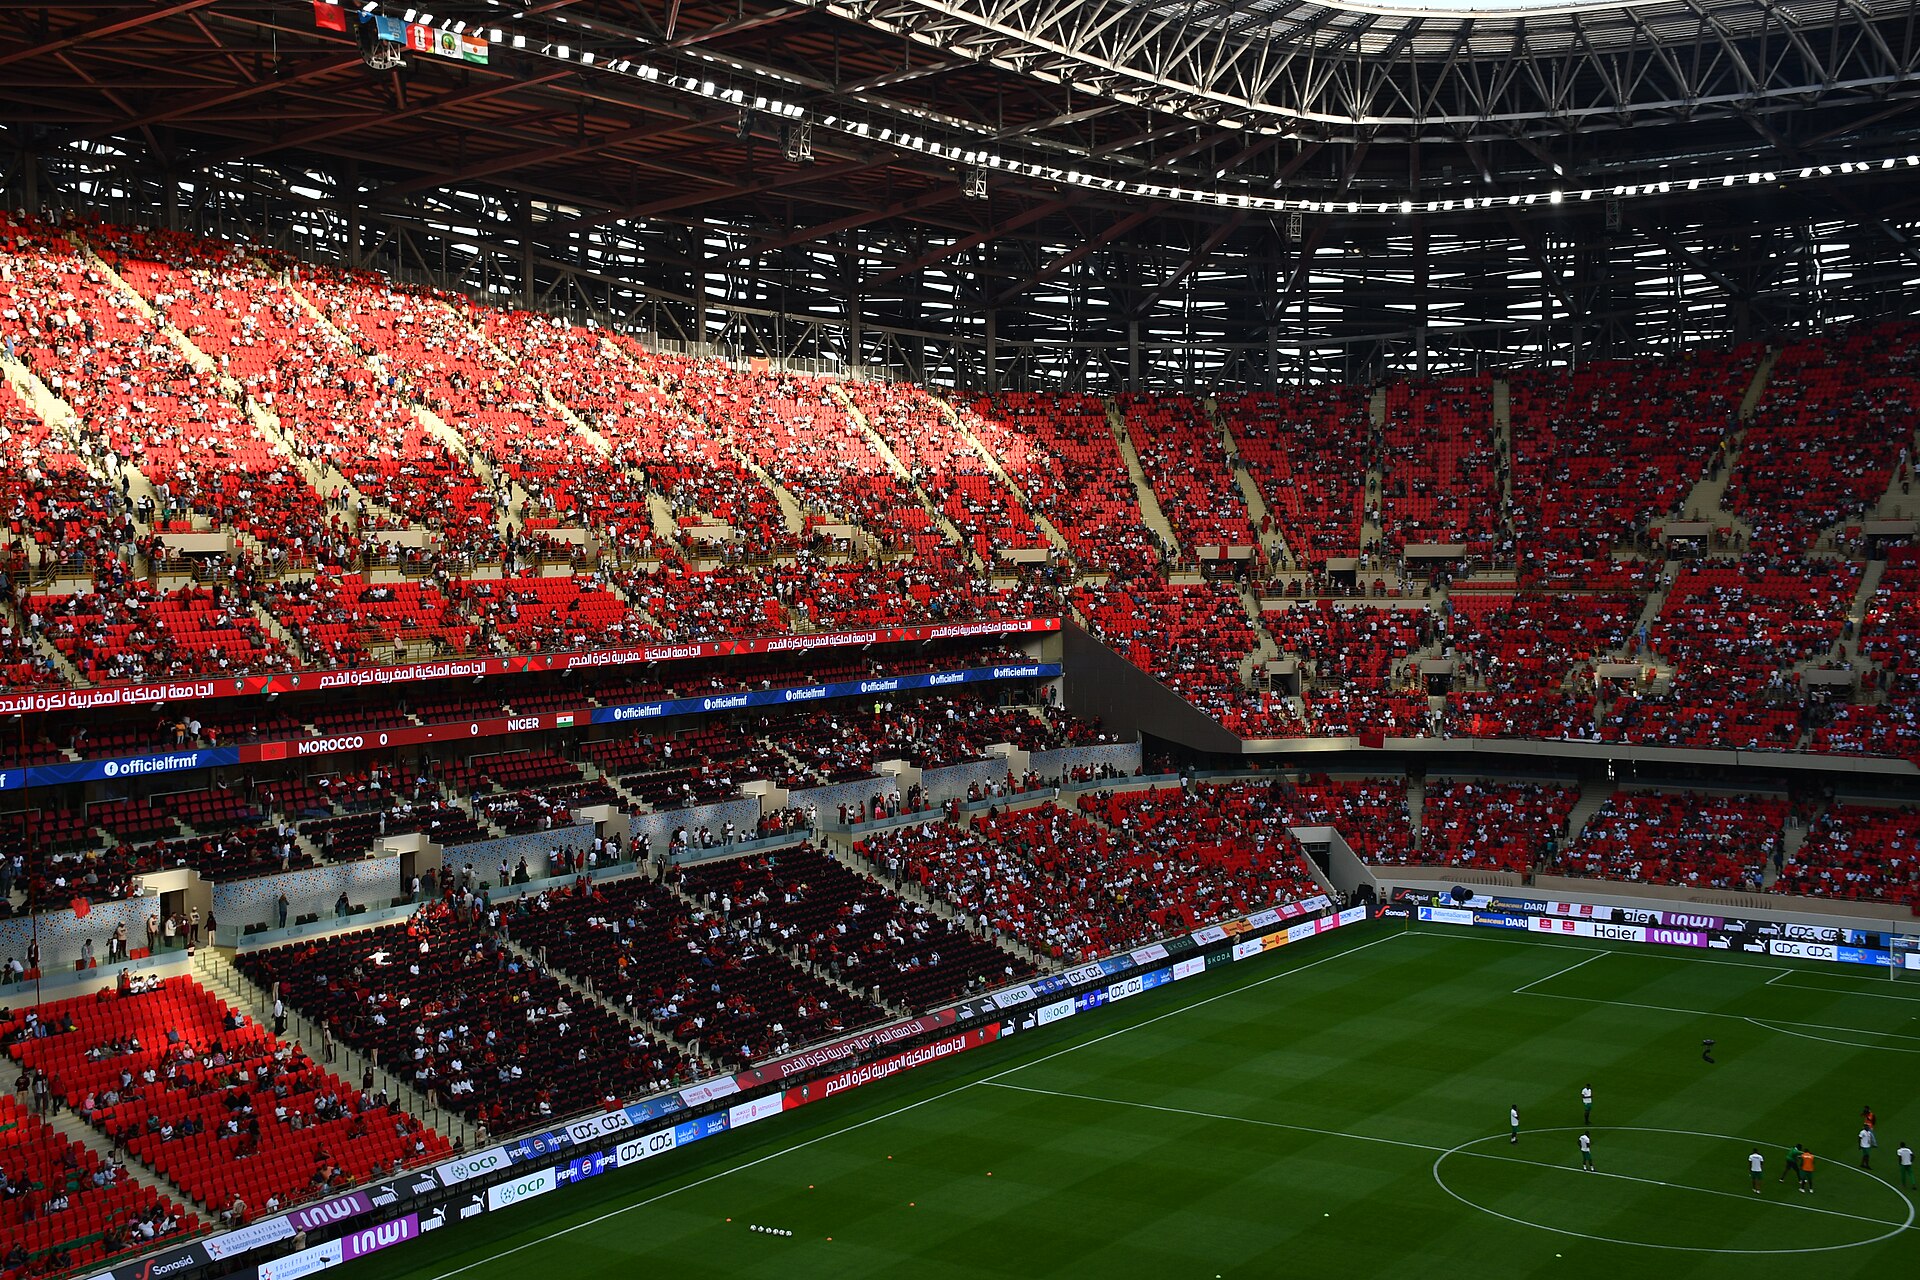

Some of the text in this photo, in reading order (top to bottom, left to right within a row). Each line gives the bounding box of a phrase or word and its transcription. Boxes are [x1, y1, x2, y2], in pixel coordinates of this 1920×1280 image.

[351, 670, 374, 686] لكرة
[375, 667, 414, 684] المغربية
[415, 664, 450, 681] الملكية
[999, 666, 1039, 678] officielfrmf
[319, 672, 350, 690] القدم
[68, 689, 120, 709] المغربية
[122, 685, 166, 705] الملكية
[792, 687, 826, 700] officielfrmf
[36, 693, 66, 712] لكرة
[711, 695, 748, 710] officielfrmf
[622, 704, 662, 719] officielfrmf
[299, 735, 363, 755] MOROCCO
[379, 733, 388, 746] 0
[470, 723, 478, 736] 0
[507, 717, 539, 732] NIGER
[120, 753, 197, 774] officielfrmf
[1523, 902, 1546, 911] DARI
[1505, 917, 1527, 928] DARI
[1594, 924, 1637, 940] Haier
[1789, 926, 1815, 937] CDG
[1774, 942, 1801, 955] CDG
[1806, 945, 1833, 958] CDG
[1010, 990, 1028, 1001] OCP
[1053, 1004, 1069, 1017] OCP
[806, 1049, 828, 1067] لكرة
[906, 1046, 935, 1068] الملكية
[780, 1058, 808, 1077] القدم
[826, 1073, 851, 1097] القدم
[851, 1067, 871, 1086] لكرة
[573, 1113, 629, 1140] CDG CDG
[548, 1133, 570, 1146] PEPSI
[621, 1132, 672, 1162] CDG CDG
[508, 1145, 532, 1158] PEPSI
[468, 1155, 498, 1172] OCP
[595, 1154, 616, 1168] PEPSI
[556, 1167, 578, 1182] PEPSI
[412, 1179, 437, 1194] PUMA
[516, 1177, 545, 1196] OCP
[372, 1192, 397, 1207] PUMA
[460, 1202, 483, 1220] PUMA
[420, 1215, 443, 1233] PUMA
[152, 1254, 194, 1275] Sonasid
